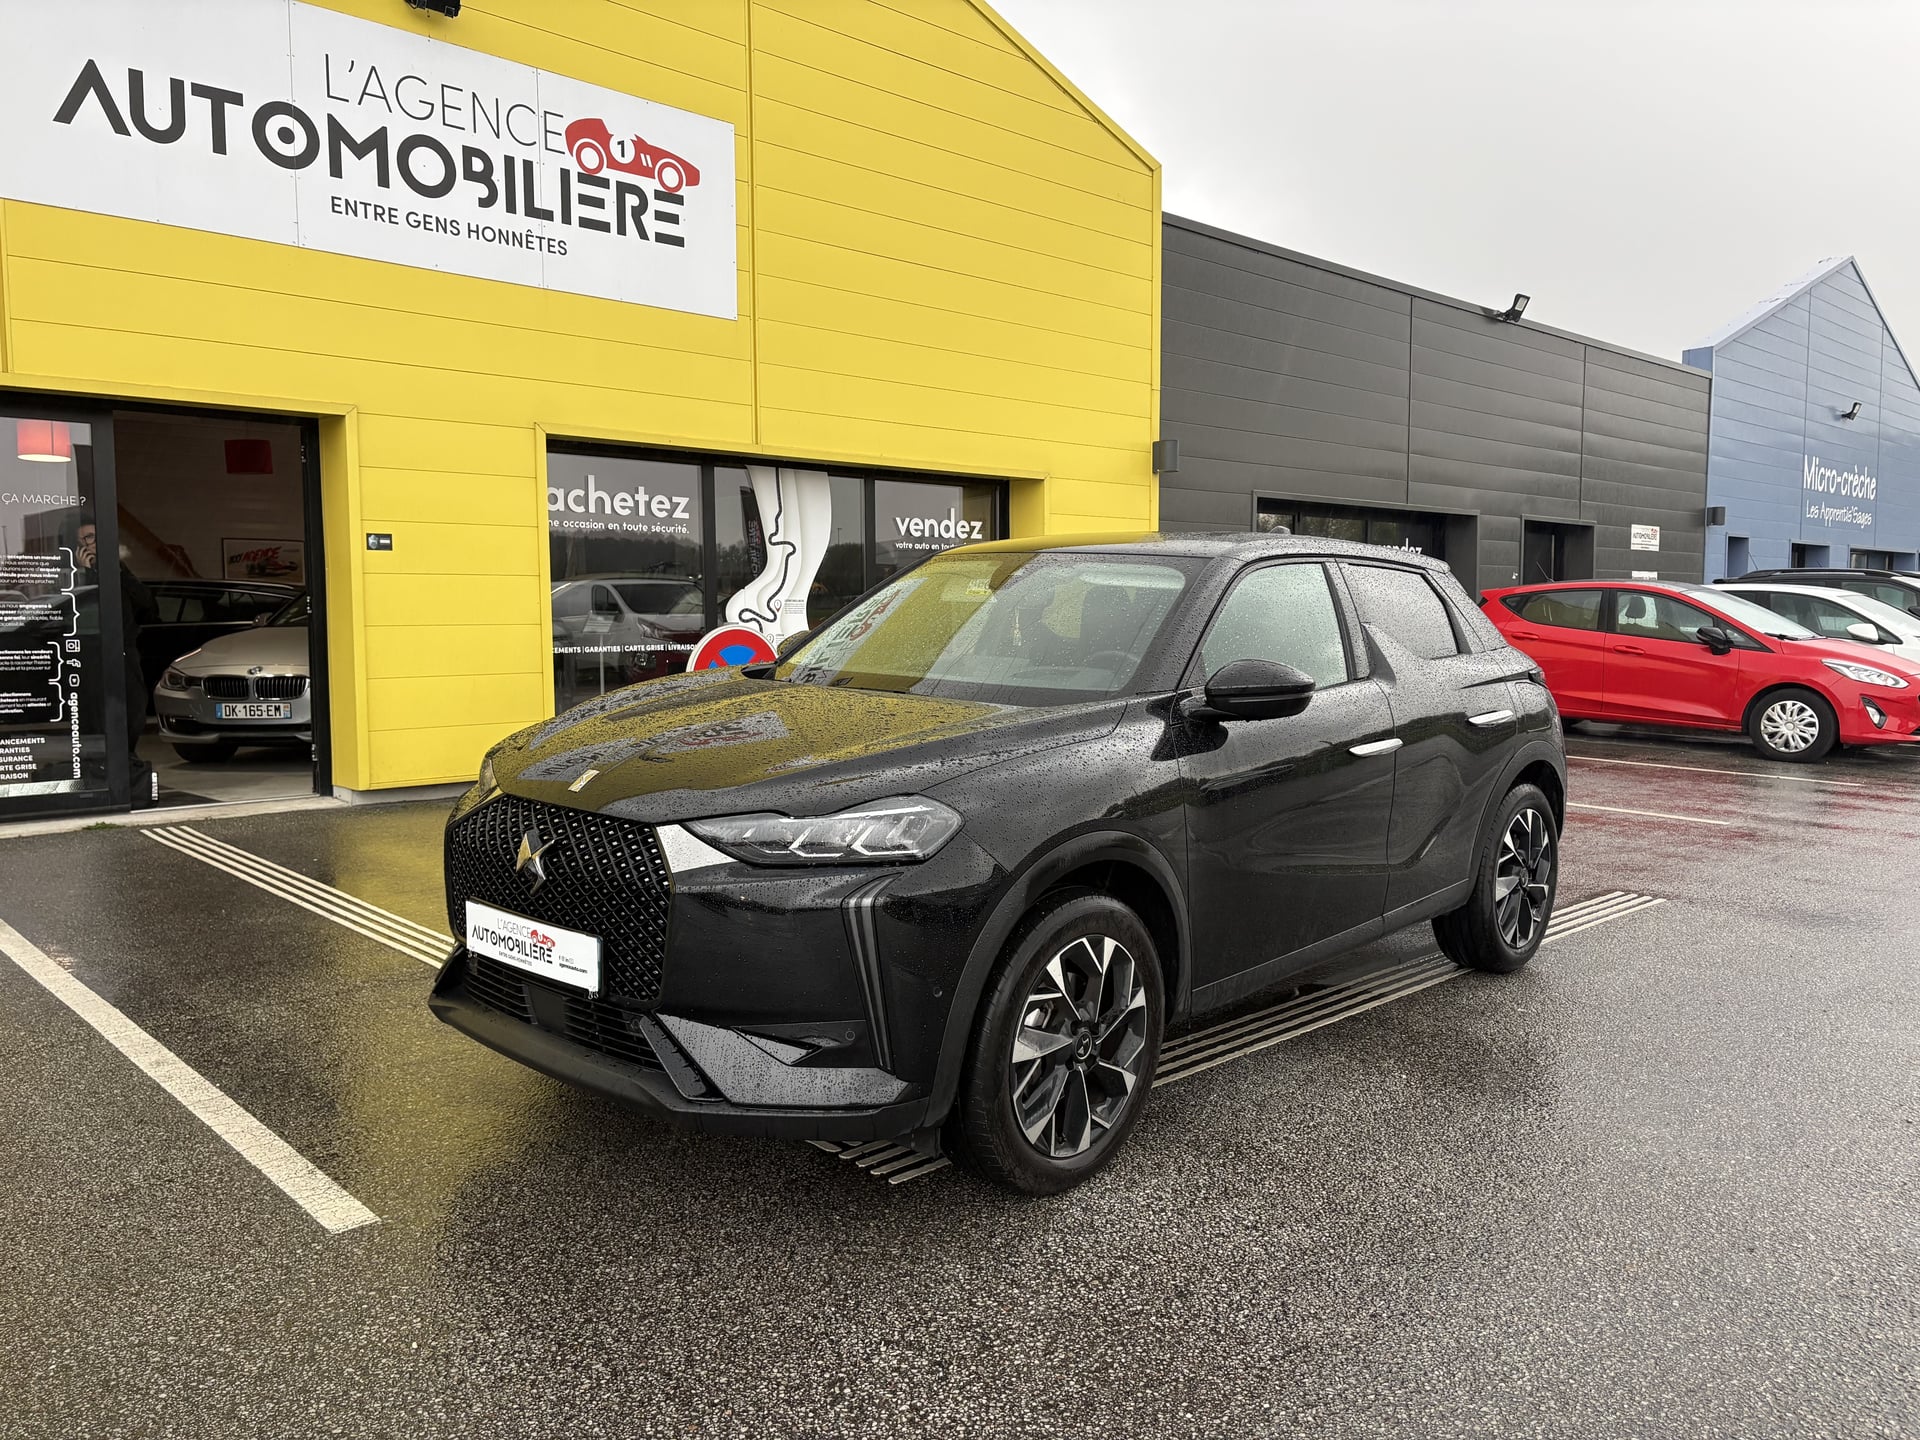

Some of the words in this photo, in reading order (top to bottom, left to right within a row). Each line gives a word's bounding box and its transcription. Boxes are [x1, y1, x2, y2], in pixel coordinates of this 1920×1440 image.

[325, 53, 566, 154] L'AGENCE
[52, 59, 685, 248] AUTOMOBILIERE
[617, 139, 626, 158] 1
[331, 196, 400, 224] ENTRE
[405, 211, 461, 237] GENS
[467, 224, 568, 256] HONNÊTES
[1803, 454, 1877, 500] Micro-crèche
[2, 493, 19, 505] ÇA
[22, 494, 77, 506] MARCHE
[547, 474, 690, 519] achetez
[1806, 500, 1819, 518] Les
[562, 519, 605, 530] occasion
[607, 521, 620, 530] en
[622, 521, 649, 532] toute
[895, 507, 983, 540] vendez
[895, 541, 913, 549] votre
[914, 542, 930, 550] auto
[584, 645, 621, 653] GARANTIES
[624, 644, 646, 652] CARTE
[646, 644, 665, 652] GRISE
[668, 643, 698, 651] LIVRAISO
[224, 704, 282, 717] DK-165-EM
[0, 737, 46, 745] ANCEMENTS
[68, 692, 82, 779] agenceauto.com
[0, 746, 31, 754] RANTIES
[0, 772, 29, 780] RAISON
[14, 763, 38, 771] GRISE
[497, 917, 532, 939] L'AGENCE
[471, 924, 554, 965] AUTOMOBILIERE
